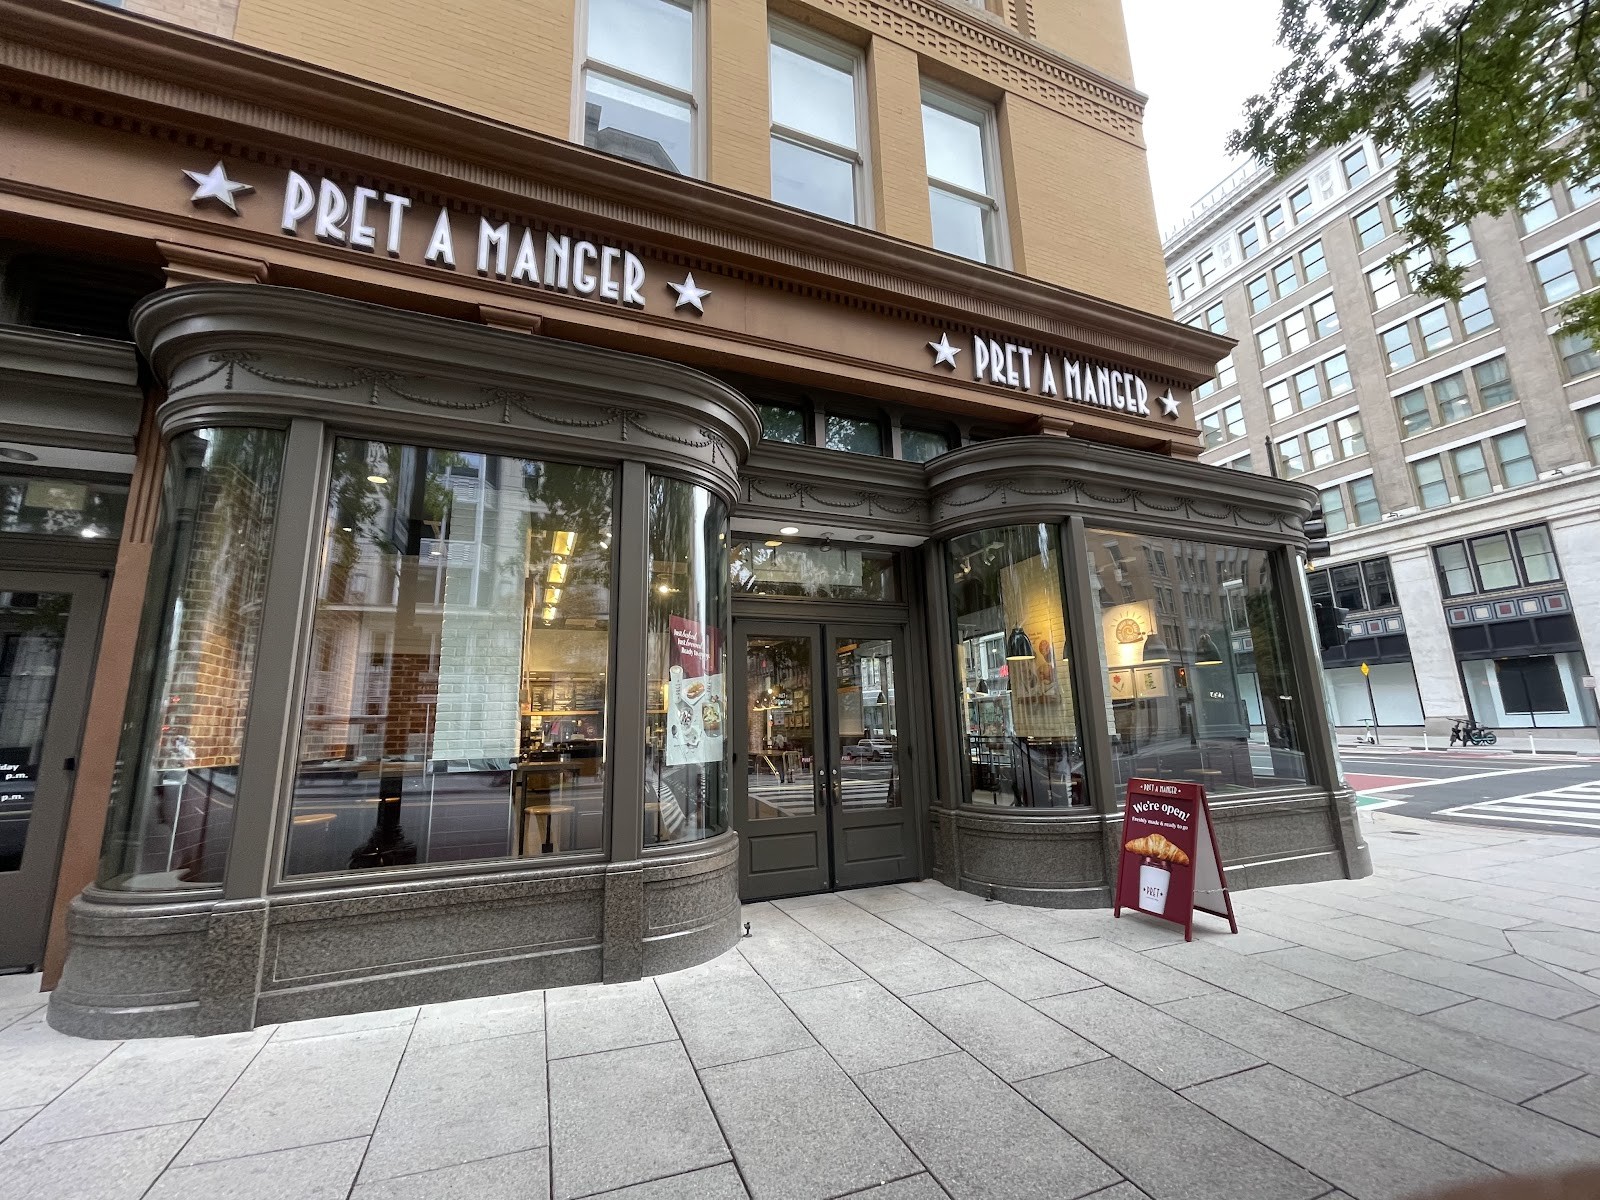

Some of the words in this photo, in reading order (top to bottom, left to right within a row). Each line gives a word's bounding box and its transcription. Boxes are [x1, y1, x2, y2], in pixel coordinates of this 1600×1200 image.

[281, 169, 411, 257] PRET
[425, 206, 456, 266] A
[476, 217, 646, 306] MANGER
[974, 335, 1032, 389] PRET
[1042, 353, 1057, 395] A
[1064, 357, 1150, 415] MANGER
[1143, 783, 1155, 792] PRET
[1, 794, 25, 802] p.m.
[1132, 800, 1160, 814] We're
[1161, 803, 1190, 821] open!
[1146, 886, 1159, 897] PRET
